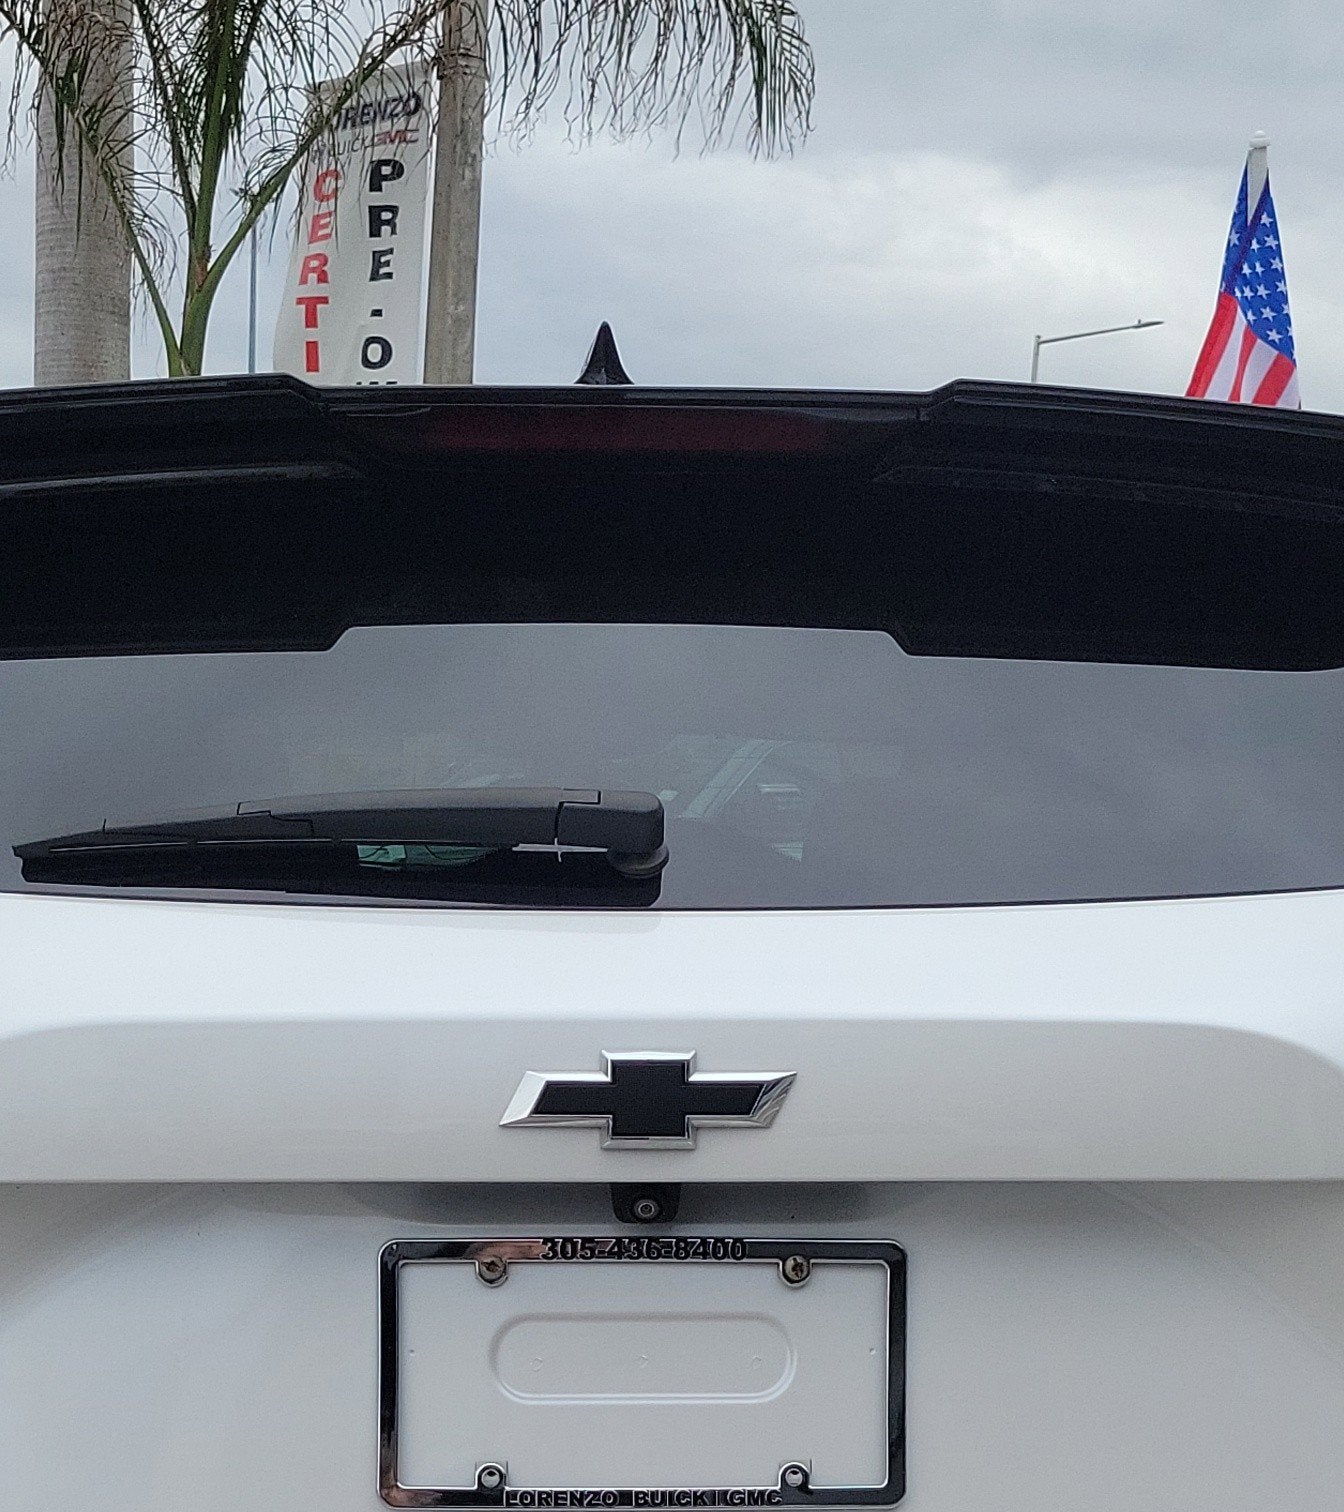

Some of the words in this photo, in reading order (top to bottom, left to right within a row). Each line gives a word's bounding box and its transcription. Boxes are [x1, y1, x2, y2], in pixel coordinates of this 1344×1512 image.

[356, 158, 405, 385] PRE-O
[539, 1237, 747, 1260] 305-436-8400
[505, 1489, 620, 1507] LORENZO
[632, 1489, 709, 1507] BUICK
[726, 1488, 783, 1507] GMC
